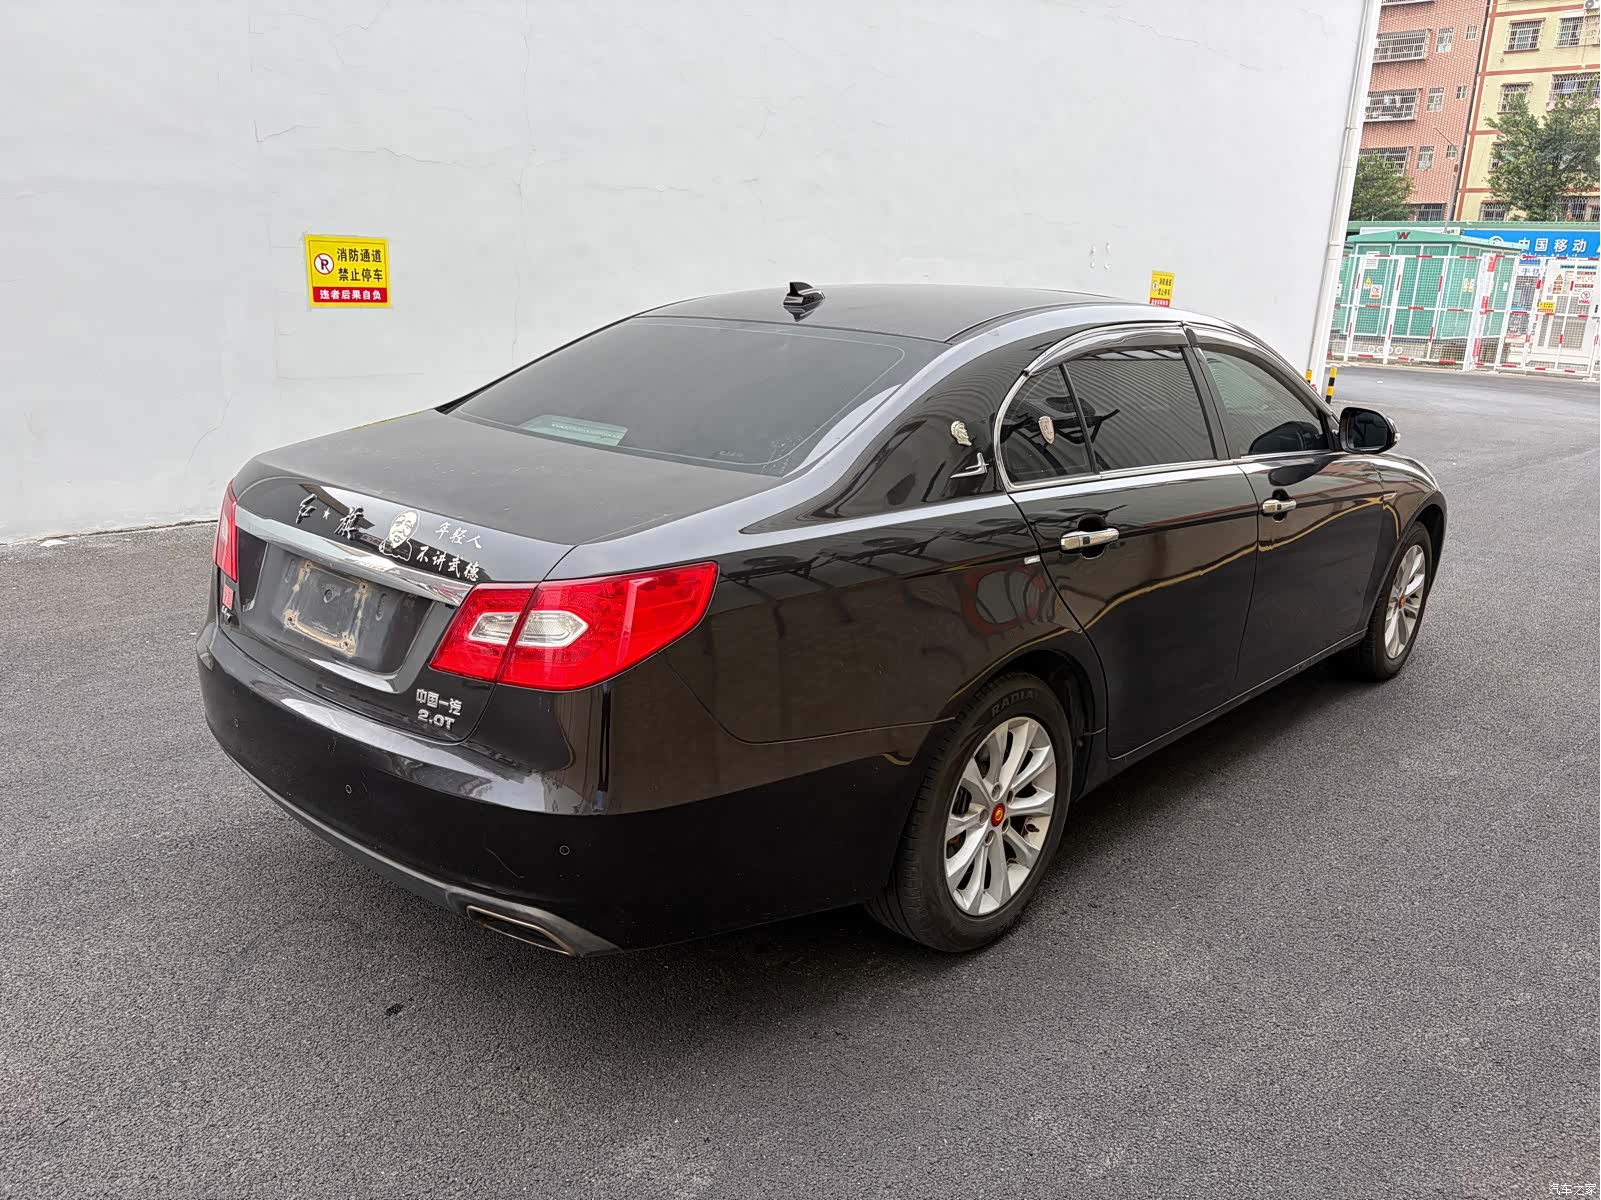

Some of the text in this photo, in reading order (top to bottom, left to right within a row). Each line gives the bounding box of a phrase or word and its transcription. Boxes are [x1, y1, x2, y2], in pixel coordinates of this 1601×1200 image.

[1518, 237, 1587, 253] 中国移动
[337, 247, 382, 263] 消防通道
[337, 267, 383, 282] 禁止停车
[319, 289, 382, 300] 违者后果自负
[435, 521, 482, 549] 年轻人
[416, 545, 480, 582] 不讲武德
[415, 688, 463, 716] 中国一汽
[417, 708, 456, 731] 2.0T
